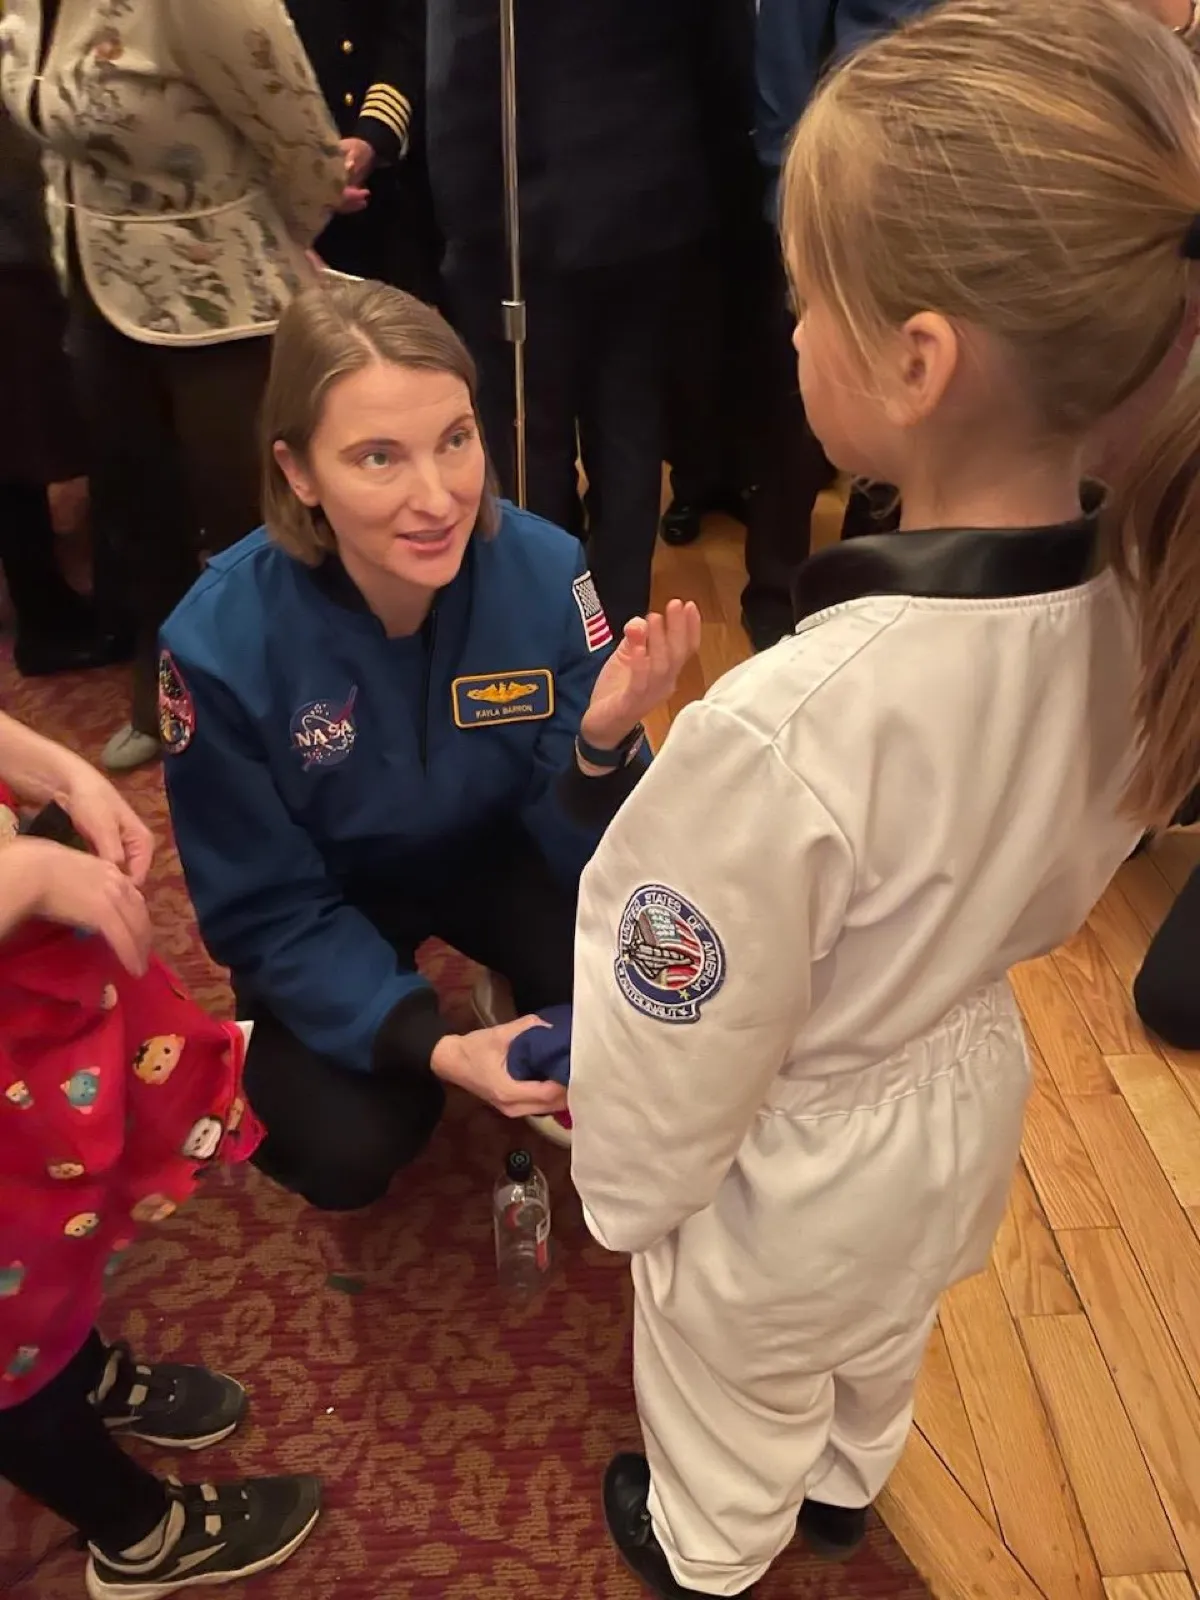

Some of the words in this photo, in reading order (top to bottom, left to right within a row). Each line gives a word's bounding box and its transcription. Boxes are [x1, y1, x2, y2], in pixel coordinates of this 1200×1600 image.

[295, 719, 354, 747] NASA
[644, 892, 682, 913] STATES
[687, 914, 705, 932] OF
[691, 940, 718, 992] AMERICA
